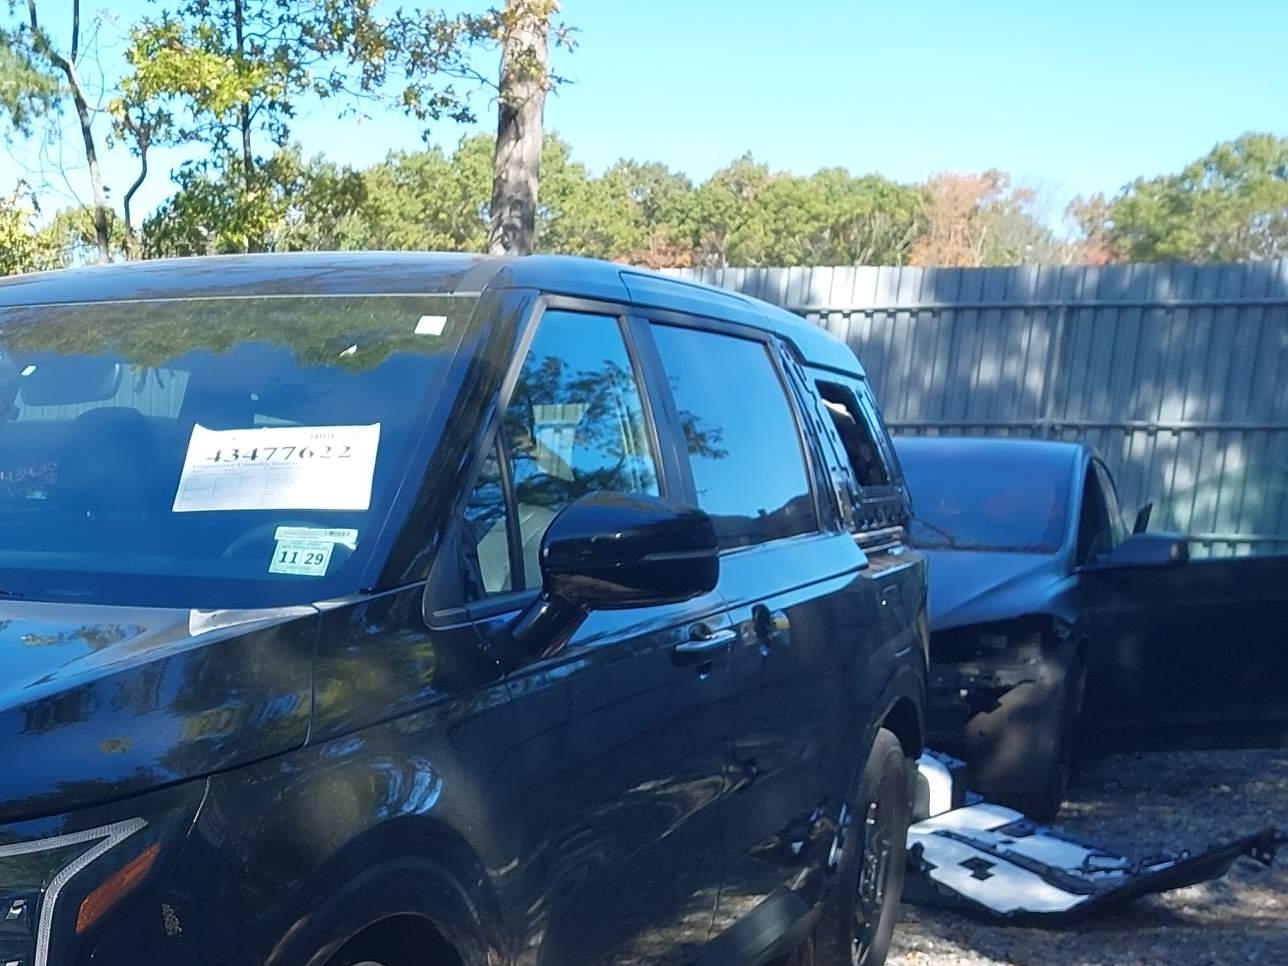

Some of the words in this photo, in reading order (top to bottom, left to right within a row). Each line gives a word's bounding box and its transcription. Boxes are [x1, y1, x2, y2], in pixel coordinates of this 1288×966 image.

[205, 446, 352, 463] 43477622
[279, 551, 298, 564] 11
[304, 552, 324, 566] 29
